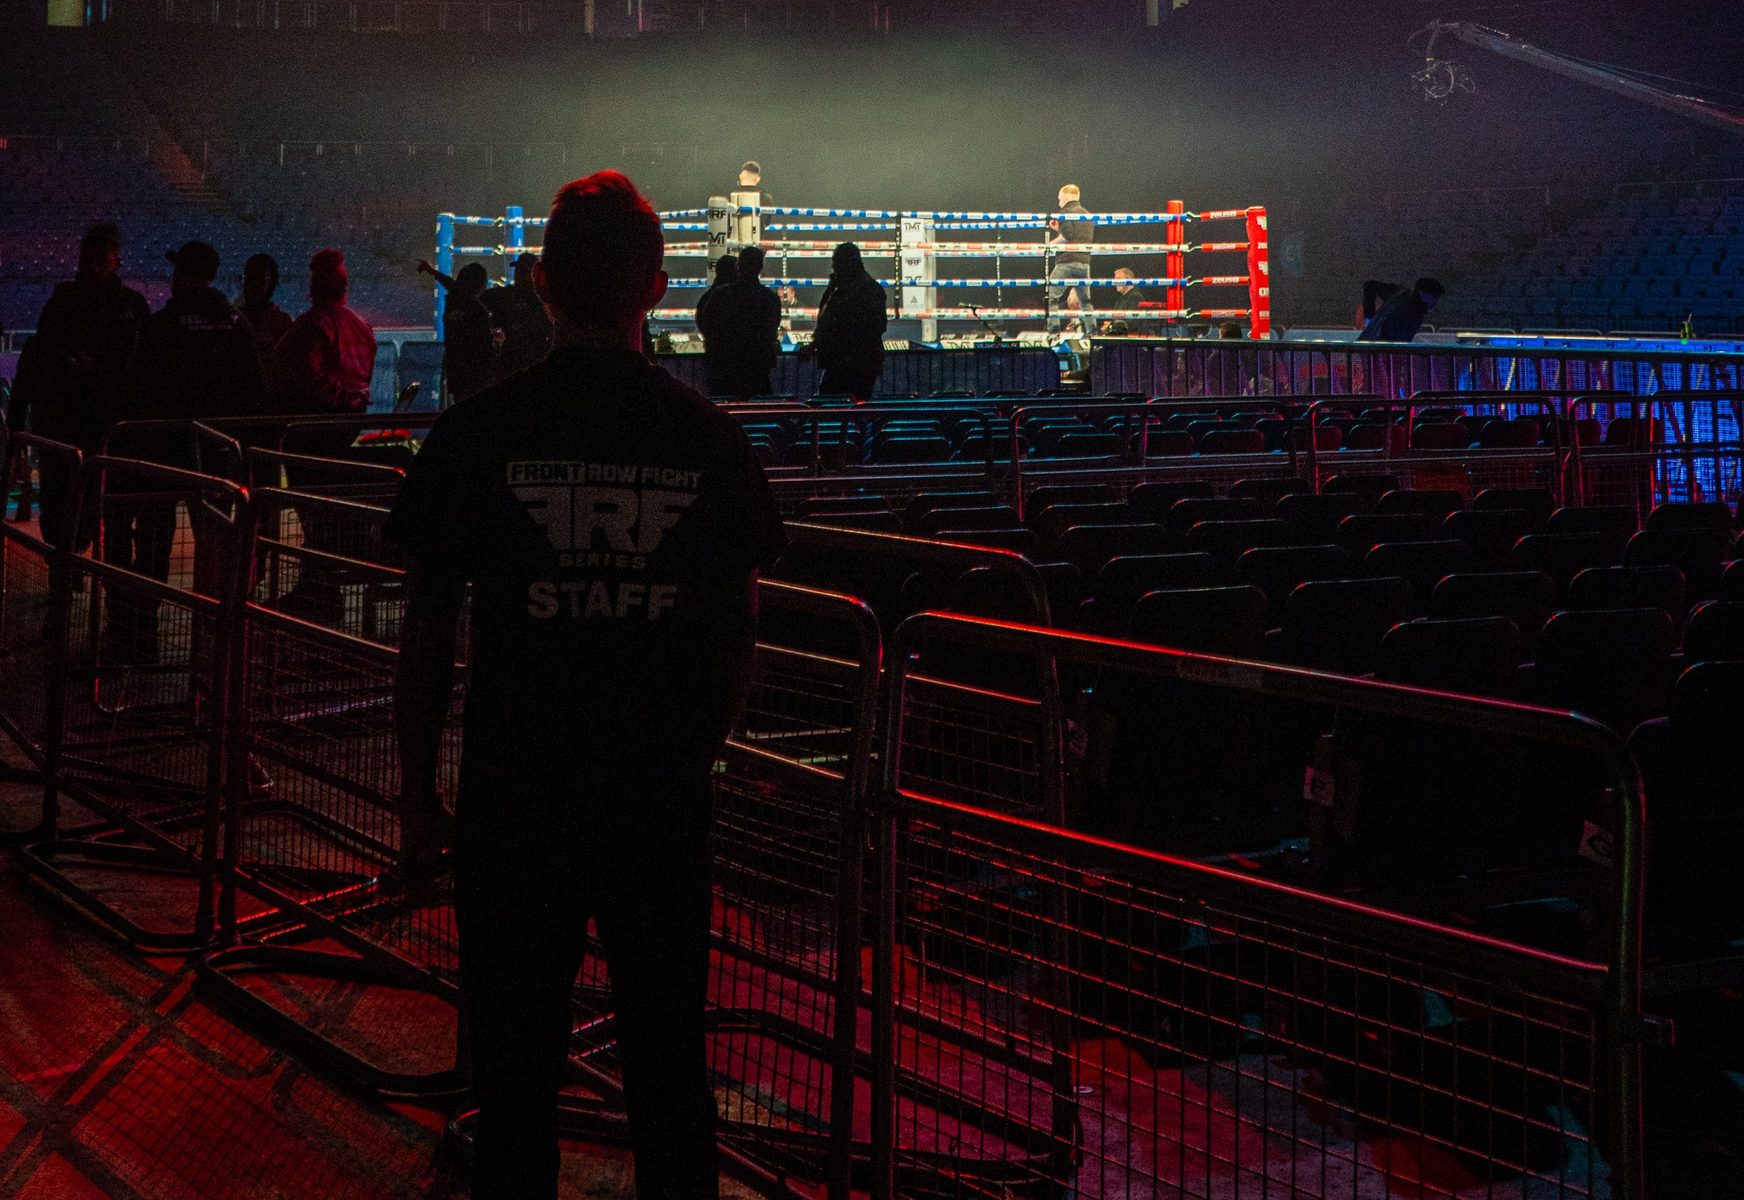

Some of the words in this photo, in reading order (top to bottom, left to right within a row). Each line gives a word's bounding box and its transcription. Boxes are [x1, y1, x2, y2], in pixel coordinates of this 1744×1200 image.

[511, 463, 585, 483] FRONT
[588, 464, 637, 483] ROW
[641, 467, 700, 489] FIGHT
[558, 552, 647, 570] SERIES
[526, 579, 678, 620] STAFF
